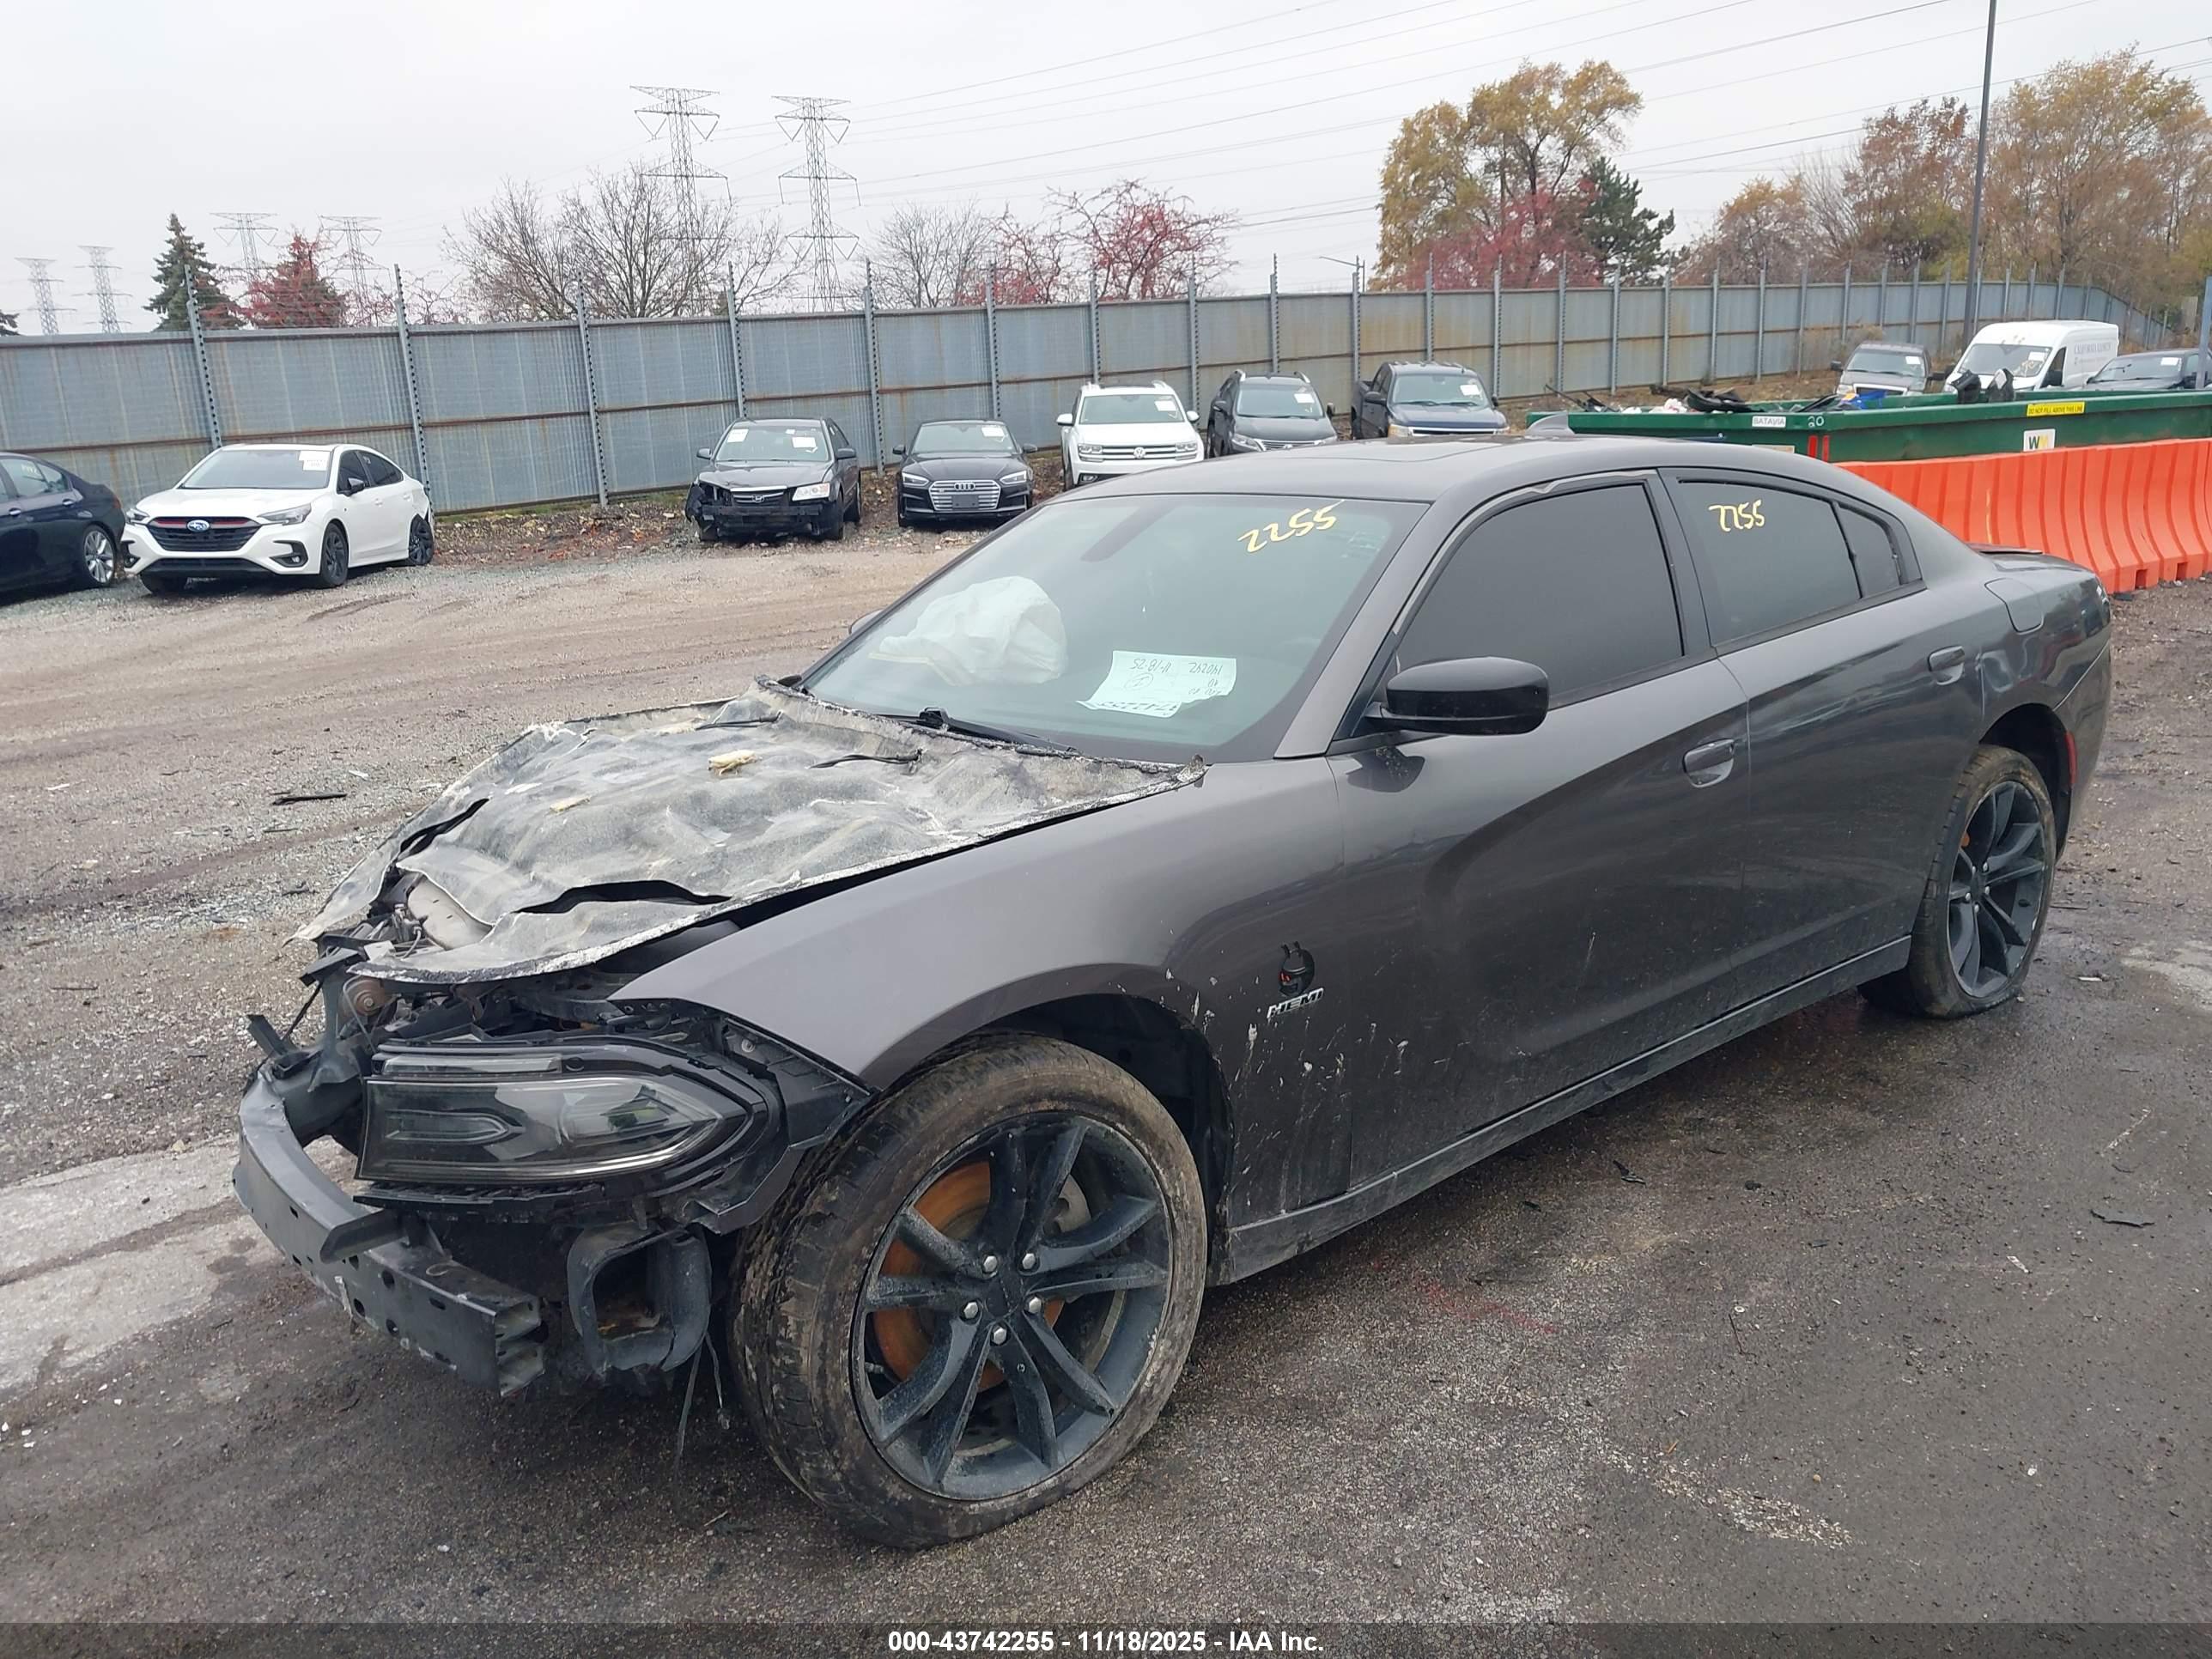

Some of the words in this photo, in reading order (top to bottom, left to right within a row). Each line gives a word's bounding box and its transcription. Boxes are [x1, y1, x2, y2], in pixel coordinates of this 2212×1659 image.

[1753, 416, 1784, 426] BATAVIA
[1808, 416, 1824, 428] 20
[2028, 435, 2048, 449] WM
[1237, 500, 1342, 553] 2255
[1267, 988, 1324, 1018] HEMI
